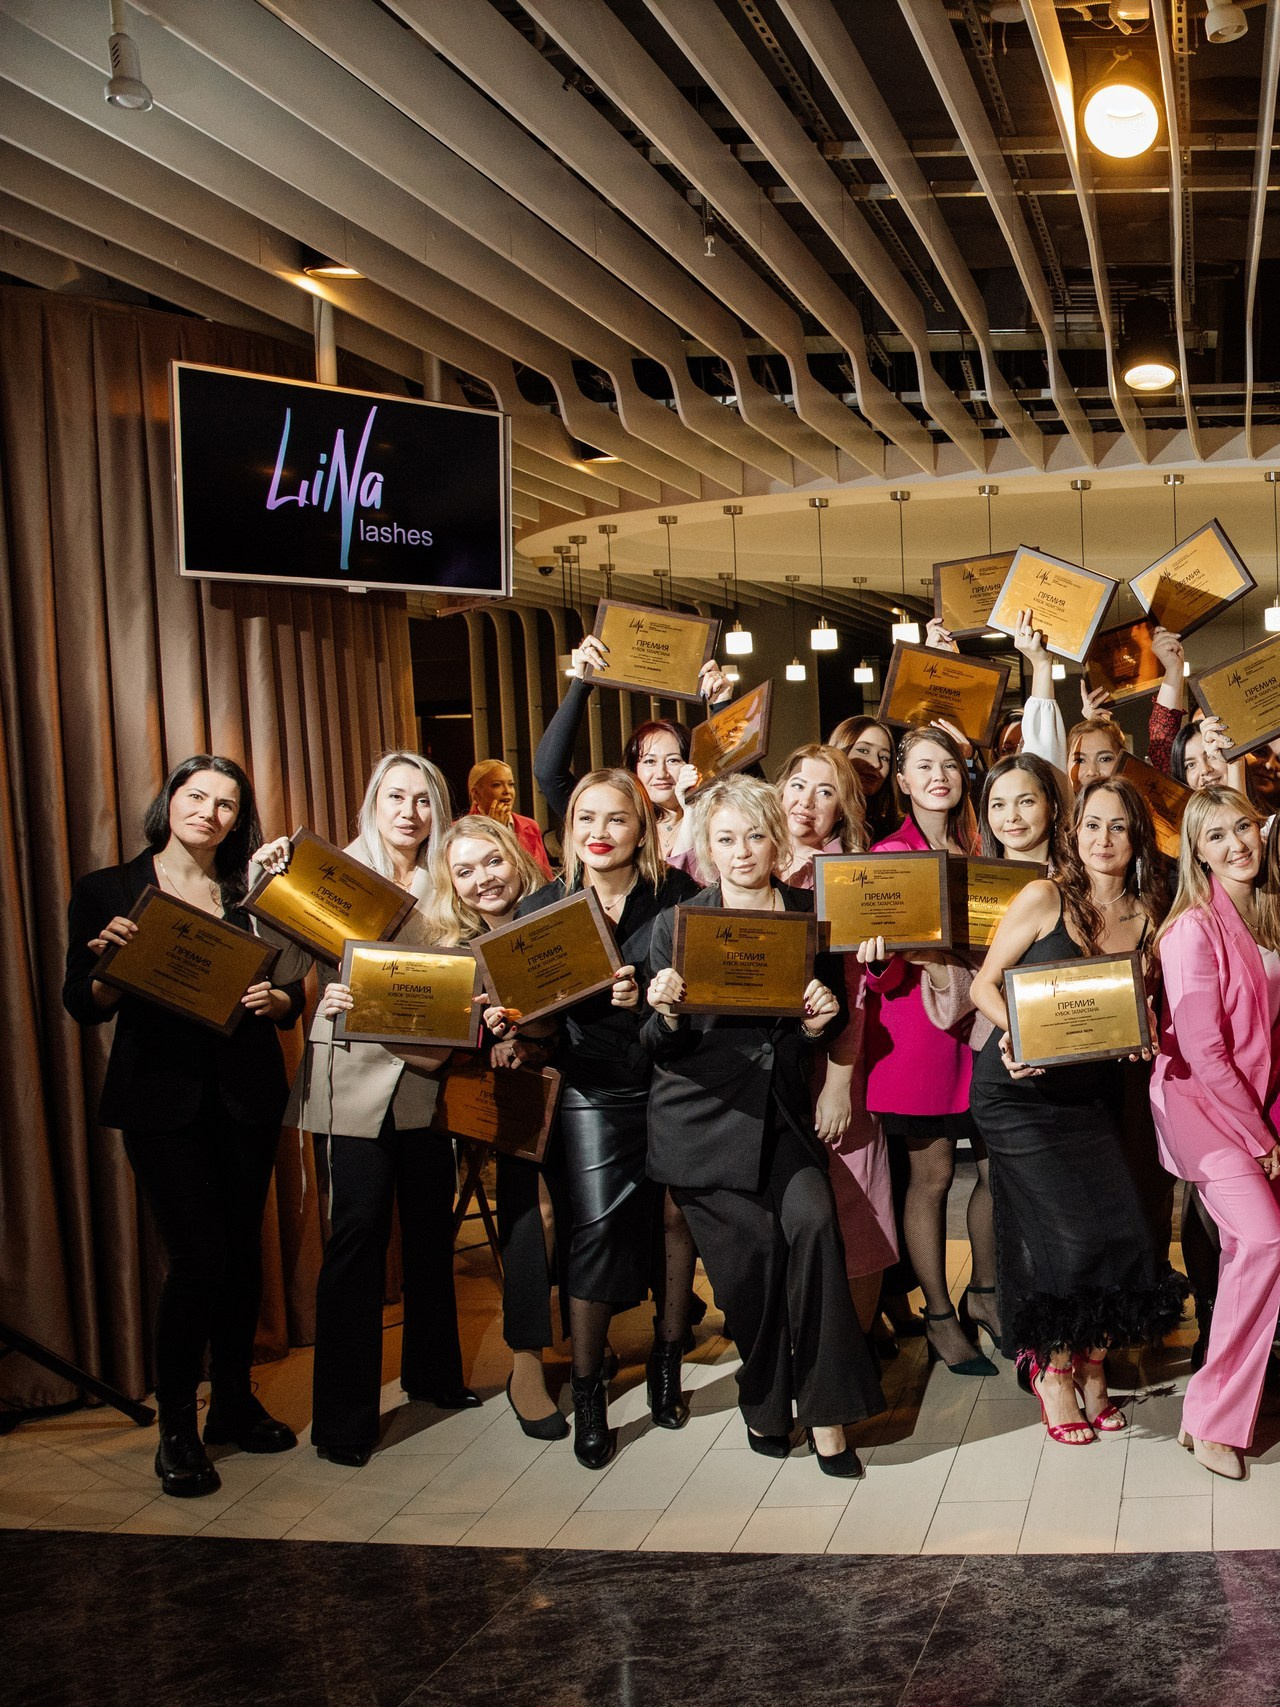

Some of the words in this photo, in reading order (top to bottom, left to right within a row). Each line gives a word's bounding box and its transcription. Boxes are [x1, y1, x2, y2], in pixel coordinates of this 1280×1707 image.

[360, 519, 433, 546] lashes
[972, 583, 1000, 593] ПРЕМИЯ
[1037, 590, 1066, 607] ПРЕМИЯ
[635, 639, 669, 651] ПРЕМИЯ
[928, 684, 961, 697] ПРЕМИЯ
[1244, 676, 1277, 697] ПРЕМИЯ
[316, 885, 352, 910] ПРЕМИЯ
[864, 891, 900, 901] ПРЕМИЯ
[172, 944, 212, 968] ПРЕМИЯ
[527, 944, 562, 966] ПРЕМИЯ
[726, 951, 765, 961] ПРЕМИЯ
[392, 983, 431, 993] ПРЕМИЯ
[1057, 997, 1095, 1010] ПРЕМИЯ
[1070, 1006, 1099, 1015] ТАТАРСТАНА
